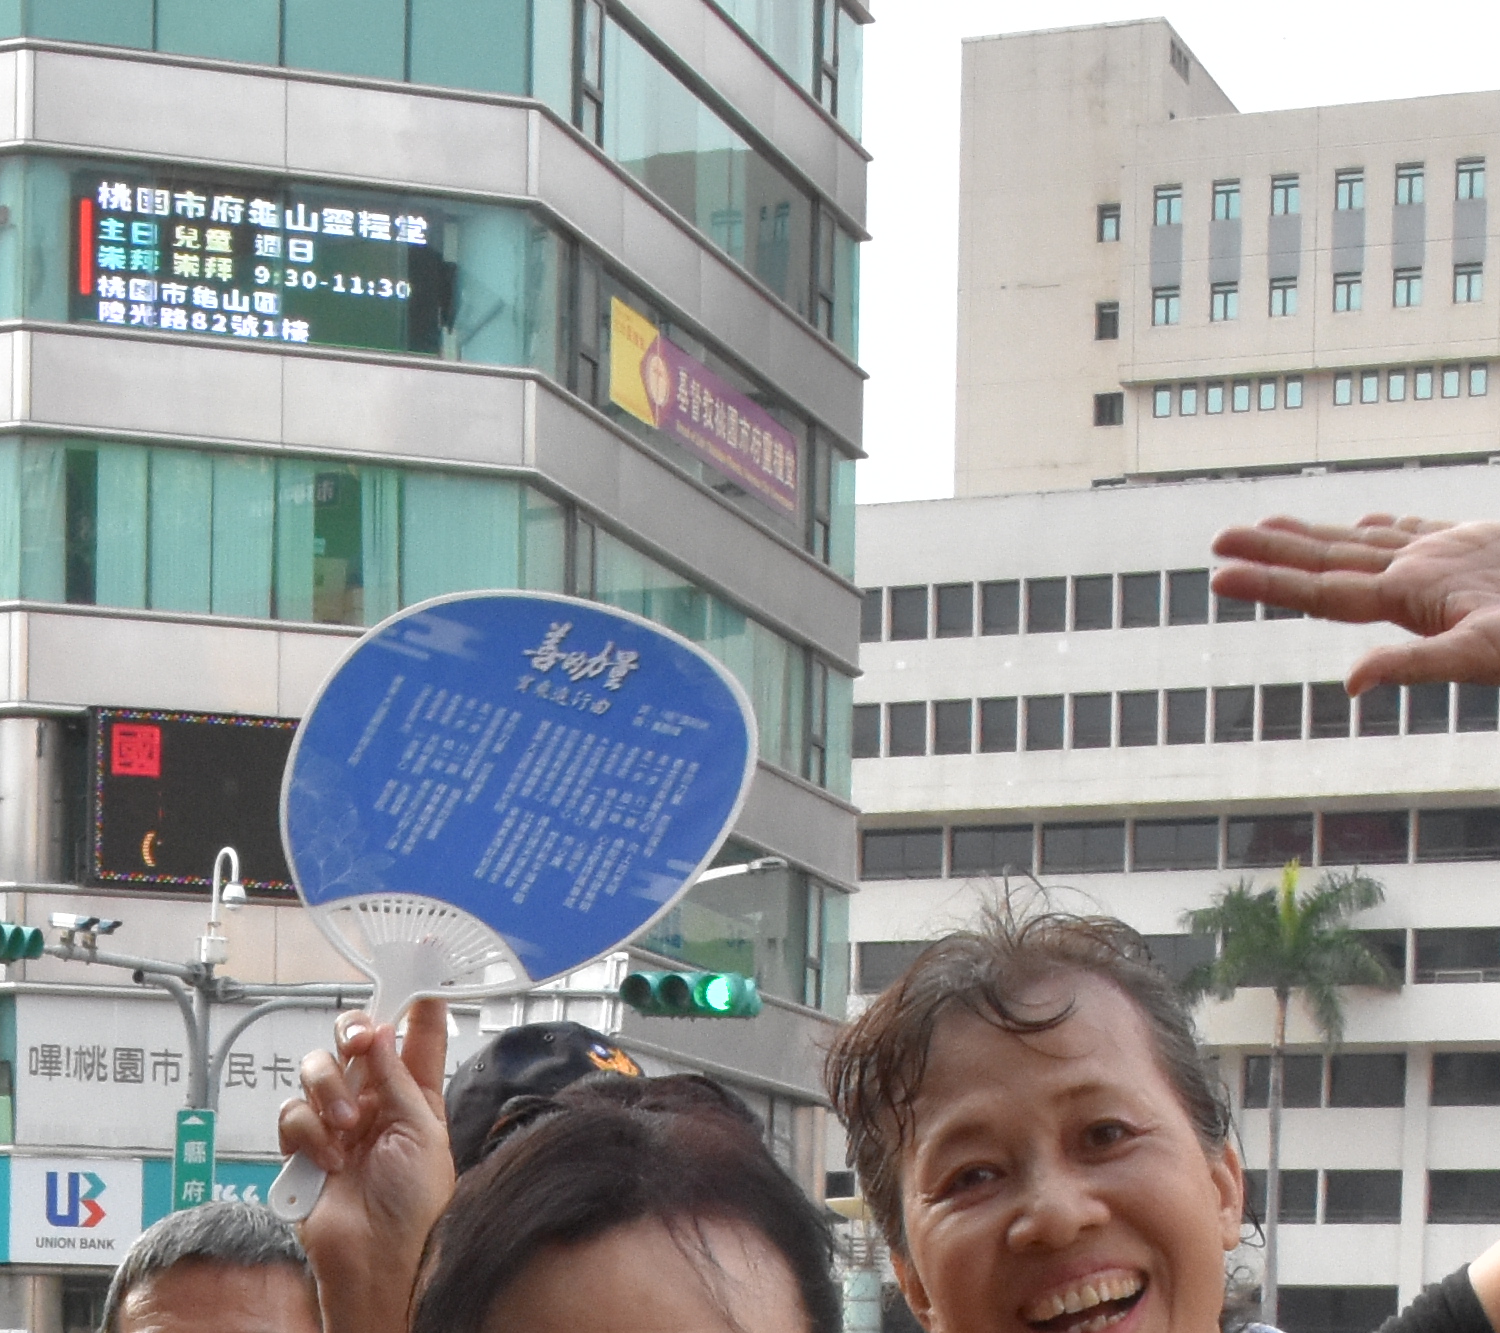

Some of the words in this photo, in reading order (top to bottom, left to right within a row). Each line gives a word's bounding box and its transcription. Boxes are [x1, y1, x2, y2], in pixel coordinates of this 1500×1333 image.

[99, 217, 158, 246] 主日
[254, 233, 315, 263] 週日
[181, 1140, 206, 1201] 縣府
[36, 1237, 77, 1250] UNION
[80, 1237, 116, 1250] BANK
